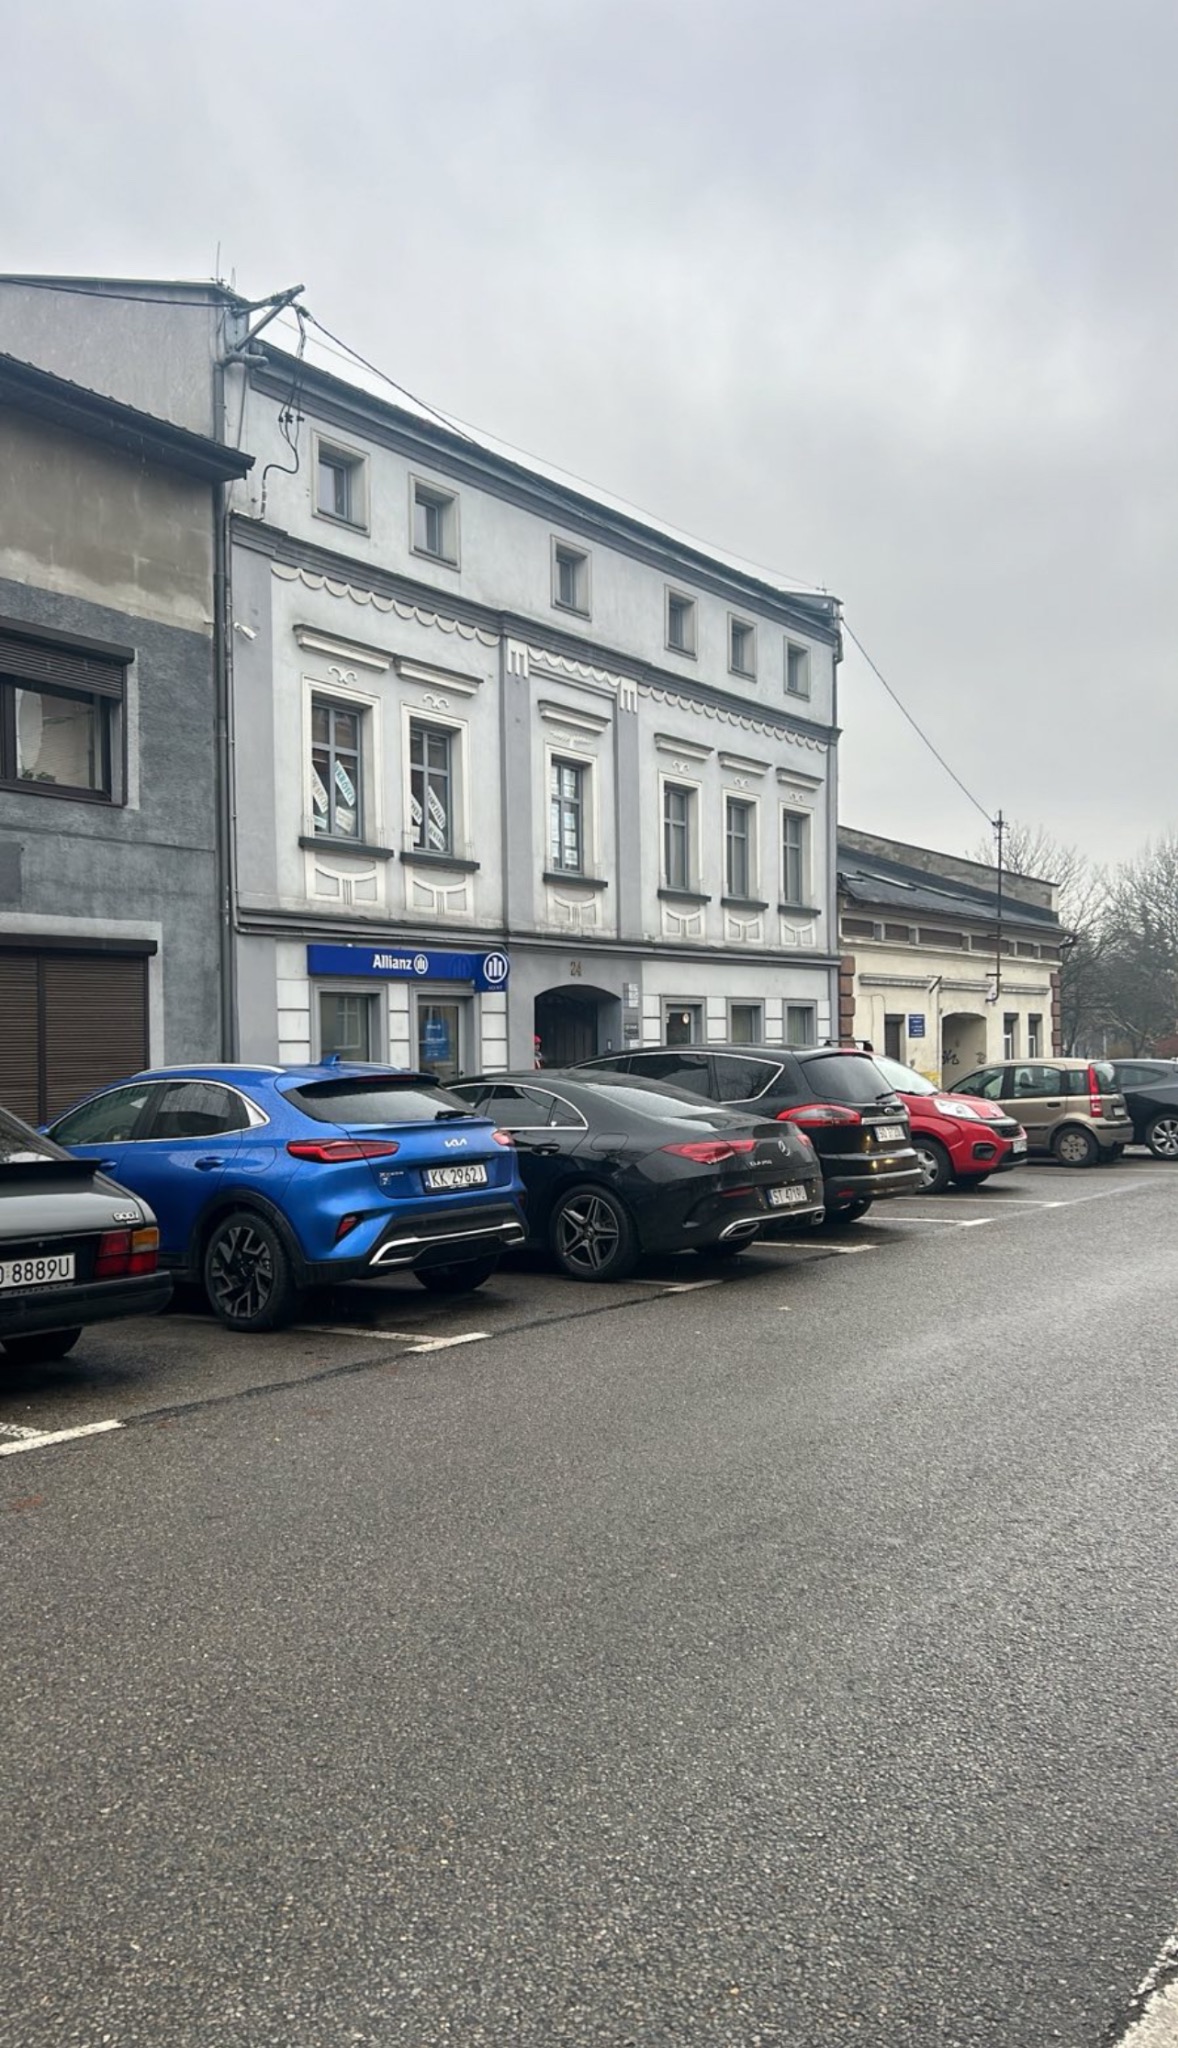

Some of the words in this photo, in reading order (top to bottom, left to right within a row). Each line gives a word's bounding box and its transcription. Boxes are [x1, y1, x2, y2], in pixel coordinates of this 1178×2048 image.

[373, 954, 412, 970] Allianz
[570, 961, 582, 977] 24
[431, 1170, 448, 1186] KK
[450, 1167, 484, 1184] 2962J
[12, 1257, 70, 1283] 8889U
